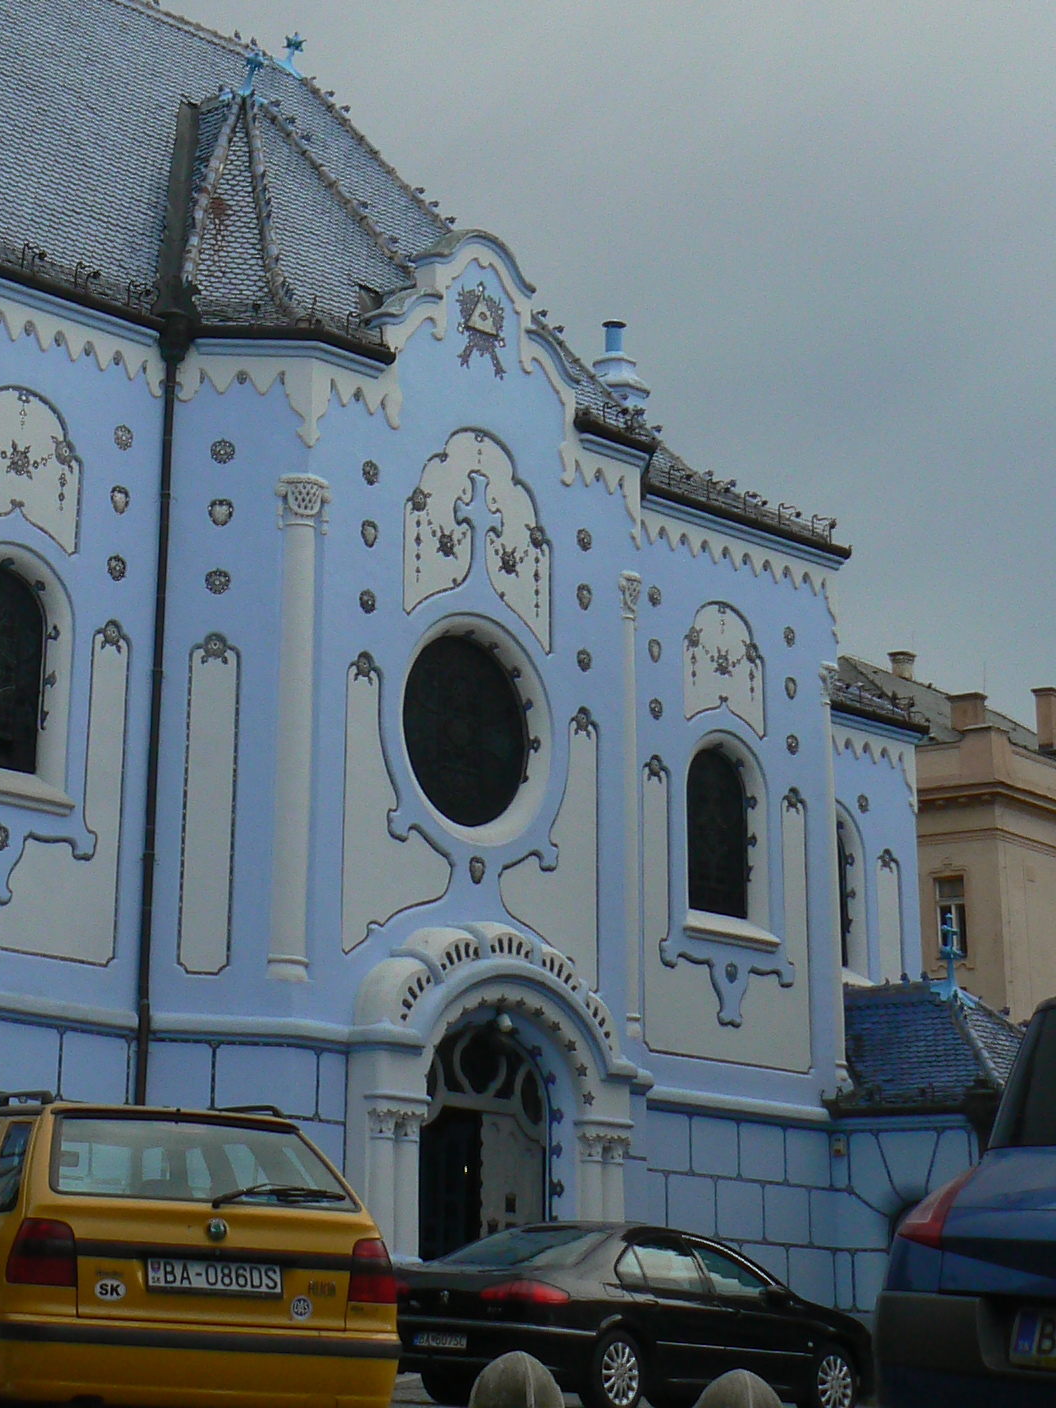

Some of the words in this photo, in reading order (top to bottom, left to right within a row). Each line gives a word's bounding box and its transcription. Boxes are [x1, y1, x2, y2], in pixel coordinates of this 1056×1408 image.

[151, 1276, 161, 1284] SK
[163, 1262, 279, 1291] BA-086DS
[99, 1283, 122, 1297] SK
